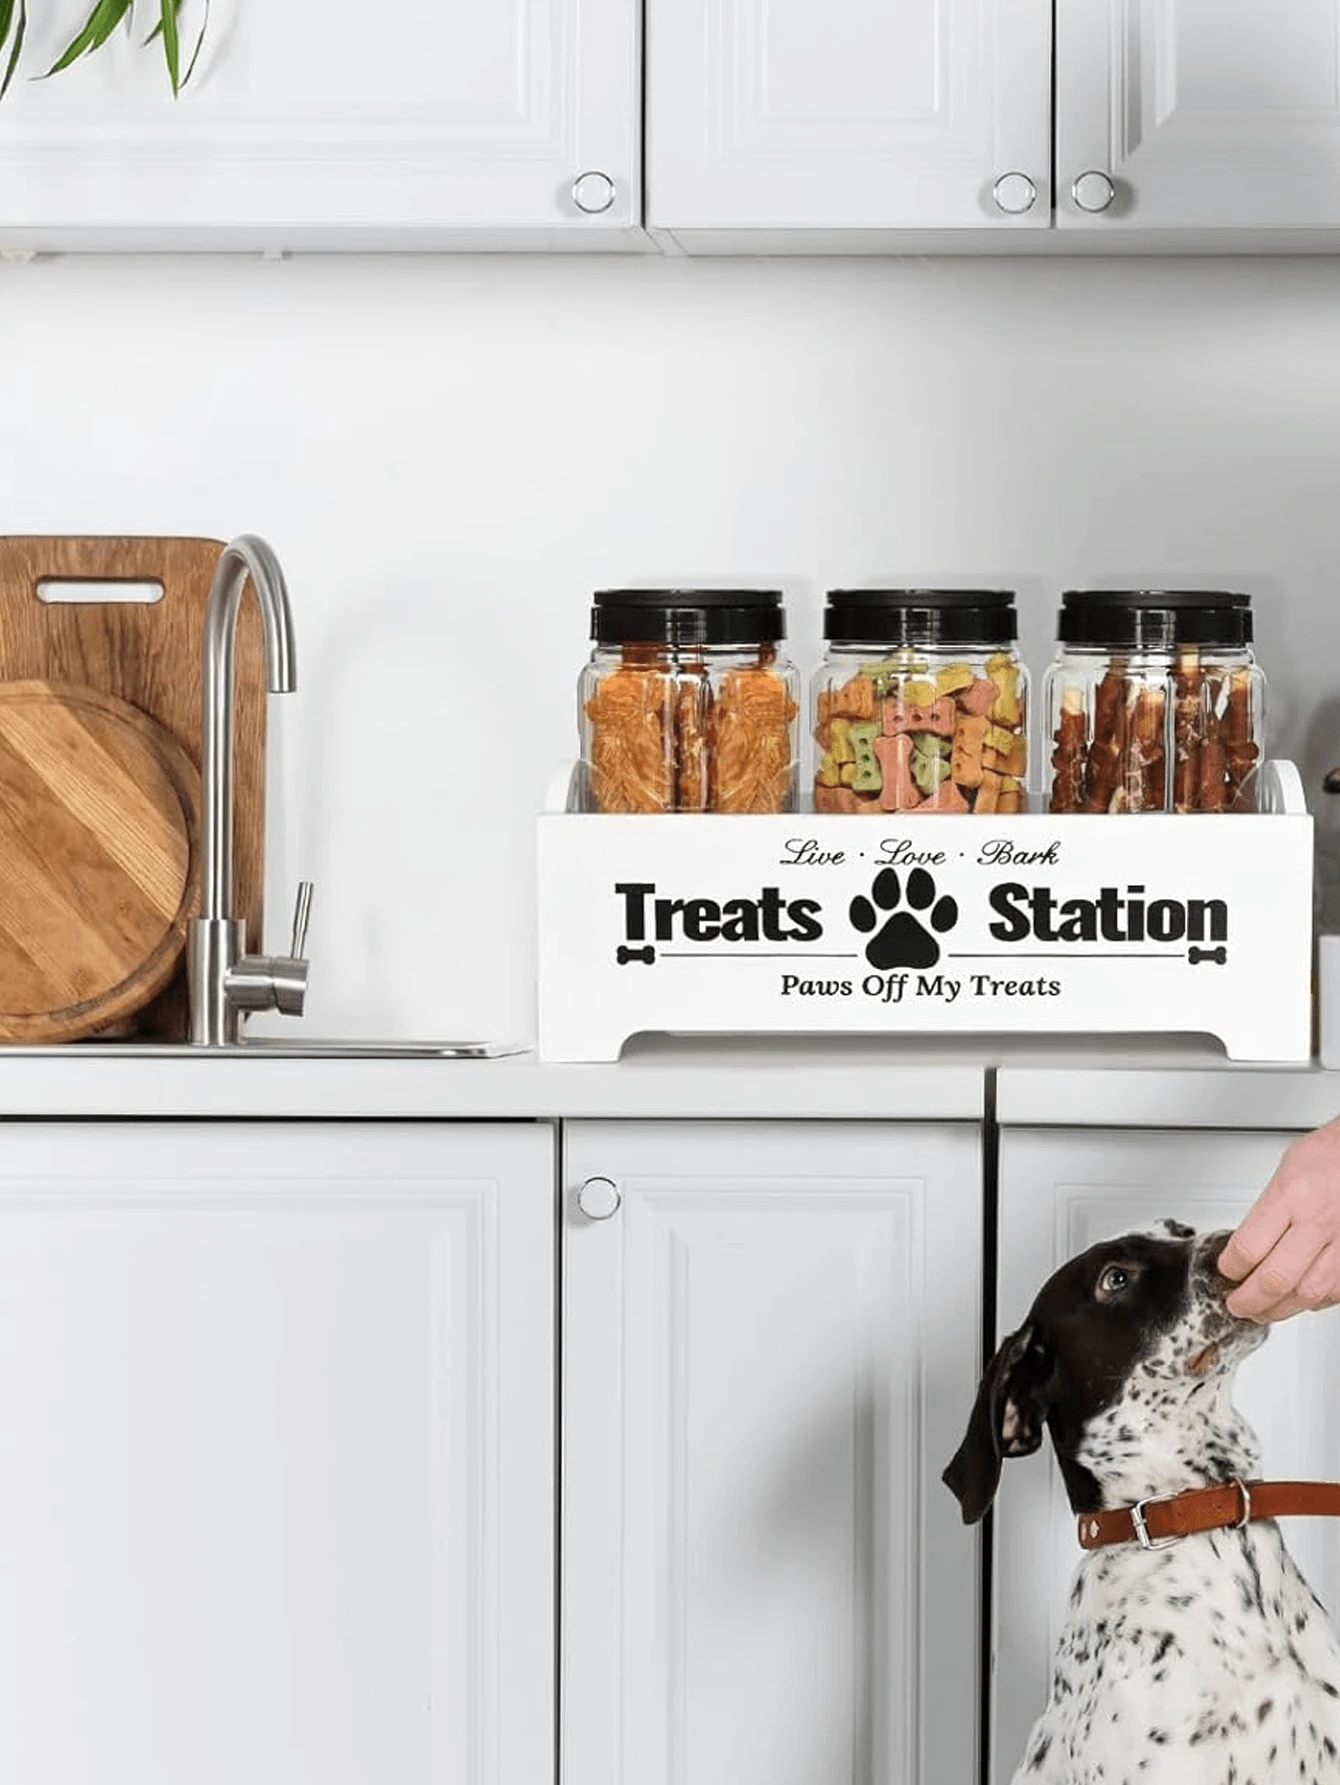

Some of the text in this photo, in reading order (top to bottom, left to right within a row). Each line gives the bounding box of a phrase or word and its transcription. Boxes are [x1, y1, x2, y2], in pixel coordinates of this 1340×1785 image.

[779, 838, 1061, 866] Live Love Bark
[614, 881, 1228, 943] Treats Station
[780, 973, 1061, 1003] Paws Off My Treats
